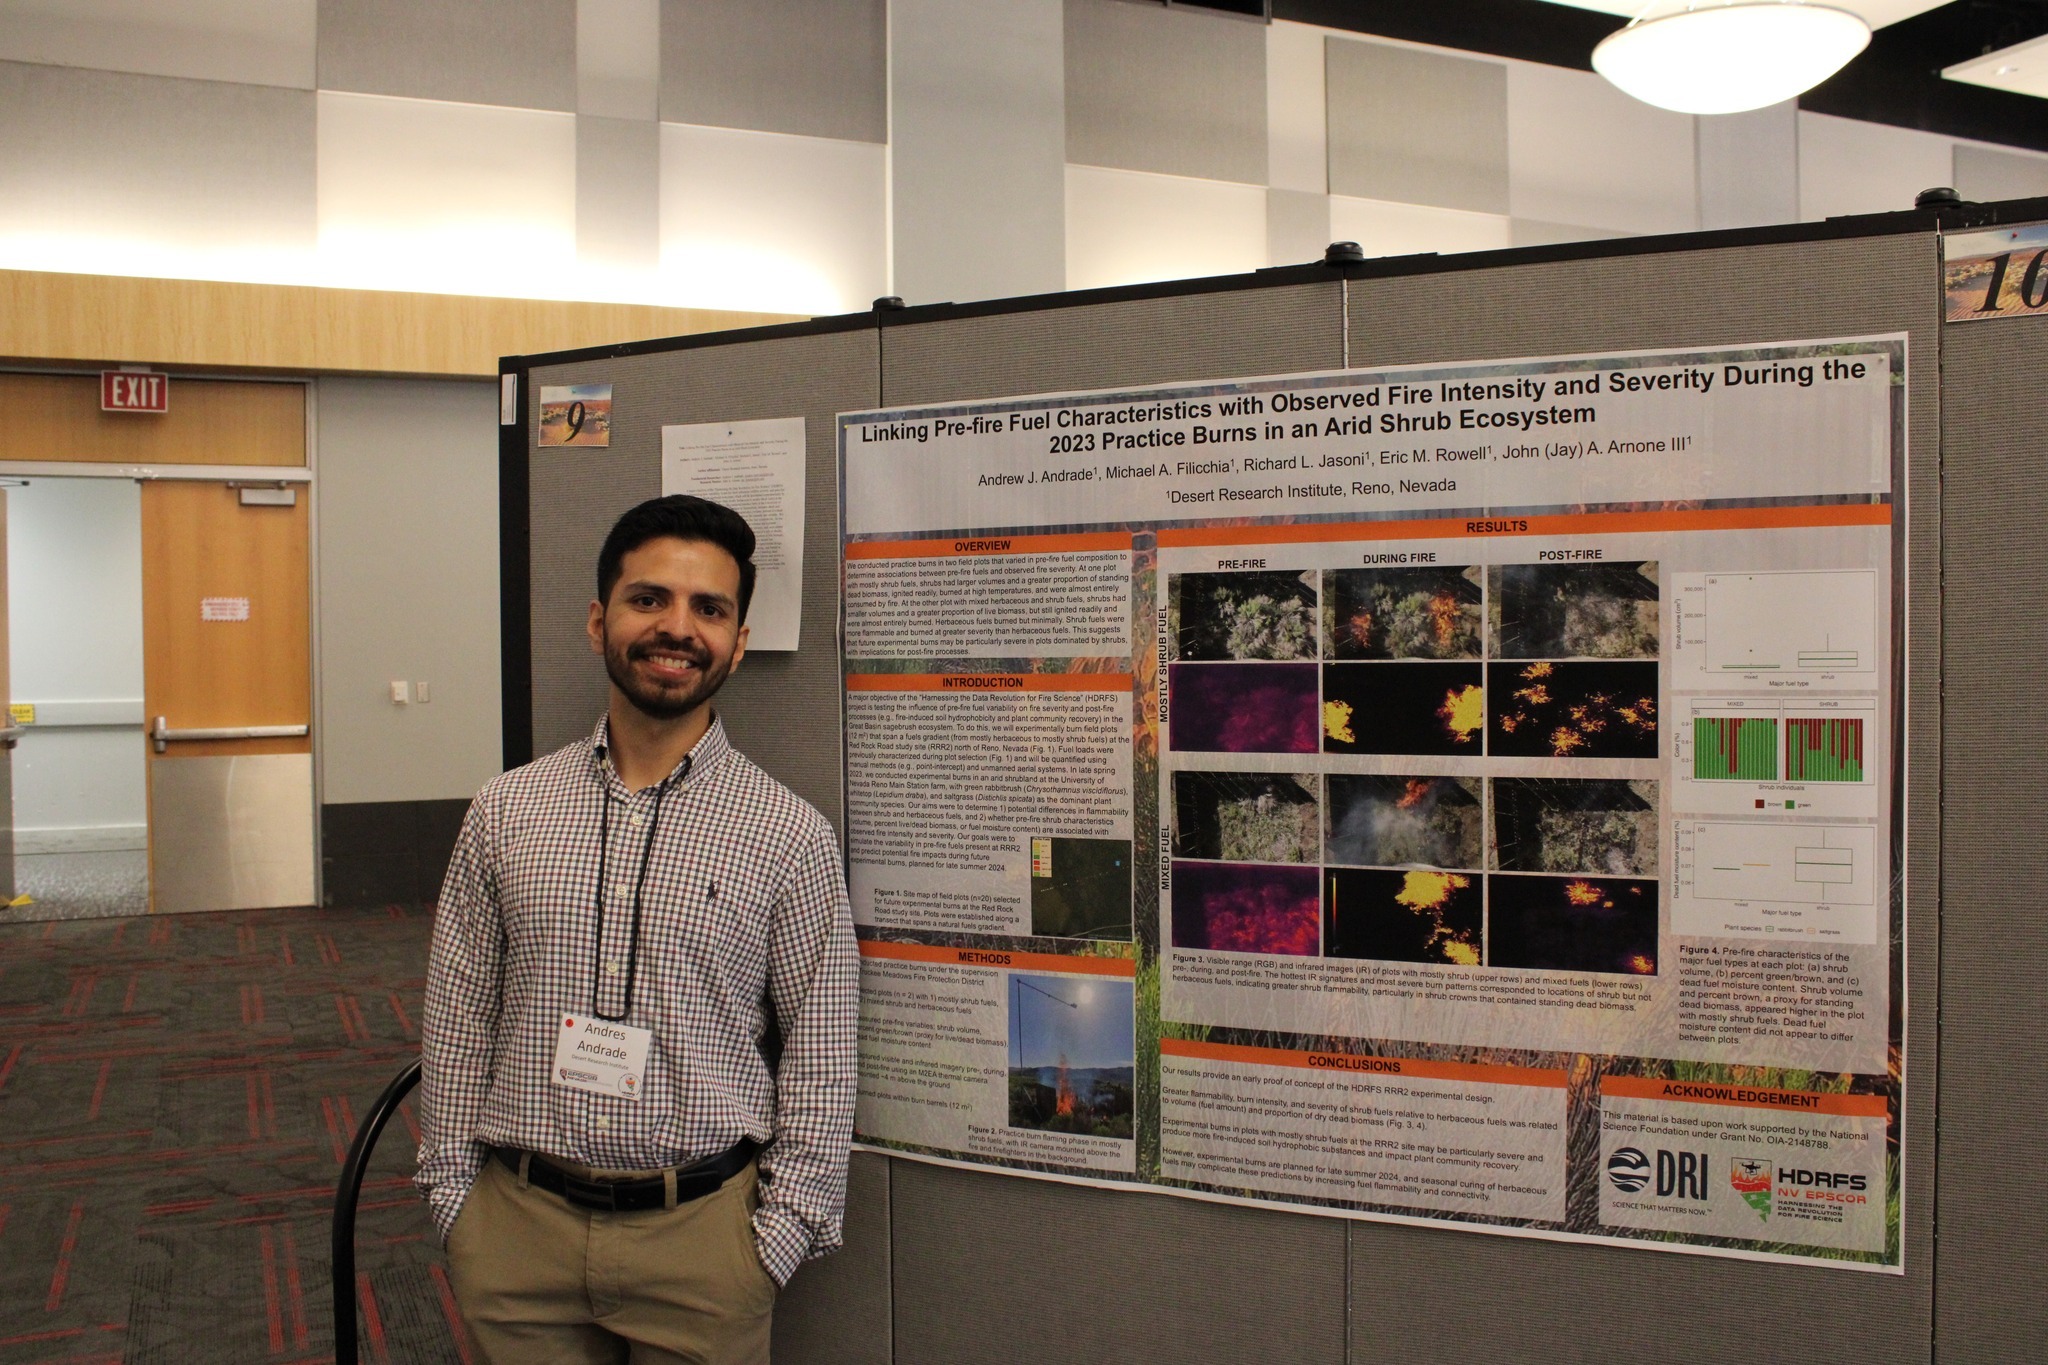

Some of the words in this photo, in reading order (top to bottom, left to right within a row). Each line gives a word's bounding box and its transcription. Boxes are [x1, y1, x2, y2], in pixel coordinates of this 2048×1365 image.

[113, 376, 160, 407] EXIT
[862, 423, 927, 441] Linking
[935, 416, 1002, 436] Pre-fire
[1010, 411, 1049, 431] Fuel
[1057, 401, 1211, 427] Characteristics
[1218, 396, 1262, 416] with
[1271, 387, 1378, 412] Observed
[1388, 385, 1432, 404] Fire
[1441, 378, 1545, 401] Intensity
[1554, 373, 1599, 395] and
[1609, 368, 1714, 392] Severity
[1724, 362, 1812, 385] During
[1822, 360, 1865, 379] the
[564, 401, 586, 442] 9
[1049, 433, 1094, 453] 2023
[1102, 428, 1184, 449] Practice
[1193, 425, 1256, 443] Burns
[1265, 421, 1283, 439] in
[1291, 423, 1317, 438] an
[1324, 414, 1371, 436] Arid
[1380, 411, 1450, 432] Shrub
[1460, 405, 1594, 430] Ecosystem
[978, 473, 1024, 485] Andrew
[1027, 471, 1037, 483] J.
[1106, 464, 1154, 478] Michael
[1158, 463, 1171, 475] A.
[1244, 456, 1296, 471] Richard
[1301, 455, 1313, 468] L.
[1380, 450, 1408, 464] Eric
[1413, 449, 1429, 462] M.
[1502, 444, 1538, 458] John
[1545, 441, 1582, 459] (Jay)
[1586, 441, 1602, 454] A.
[1607, 440, 1665, 453] Arnone
[1219, 485, 1282, 500] Research
[1288, 483, 1346, 497] Institute,
[1352, 481, 1393, 495] Reno,
[1400, 478, 1456, 492] Nevada
[1466, 520, 1527, 532] RESULTS
[954, 540, 1010, 551] OVERVIEW
[1539, 549, 1602, 560] POST-FIRE
[857, 561, 889, 569] conducted
[973, 558, 989, 566] plots
[1035, 555, 1059, 564] pre-fire
[1061, 554, 1074, 562] fuel
[1075, 553, 1118, 562] composition
[1218, 559, 1265, 569] PRE-FIRE
[1363, 553, 1406, 563] DURING
[1410, 552, 1435, 562] FIRE
[942, 677, 1022, 687] INTRODUCTION
[869, 694, 897, 702] objective
[1085, 694, 1117, 702] (HDRFS)
[1159, 678, 1167, 722] MOSTLY
[1161, 824, 1169, 852] FUEL
[1161, 856, 1169, 889] MIXED
[958, 951, 1010, 964] METHODS
[1679, 944, 1708, 955] Figure
[1711, 946, 1719, 954] 4.
[1722, 947, 1754, 956] Pre-fire
[1757, 949, 1821, 959] characteristics
[1823, 952, 1832, 960] of
[1835, 953, 1849, 961] the
[584, 1023, 626, 1041] Andres
[577, 1040, 627, 1060] Andrade
[588, 1058, 608, 1066] Research
[1308, 1055, 1400, 1072] CONCLUSIONS
[1162, 1065, 1175, 1073] Our
[1202, 1071, 1229, 1080] provide
[1242, 1075, 1261, 1084] early
[1294, 1080, 1324, 1089] concept
[1336, 1083, 1348, 1091] the
[1351, 1084, 1381, 1093] HDRFS
[1384, 1086, 1408, 1095] RRR2
[1410, 1090, 1462, 1100] experimental
[1464, 1093, 1494, 1104] design.
[1662, 1084, 1819, 1107] ACKNOWLEDGEMENT
[1602, 1121, 1637, 1132] Science
[1639, 1124, 1689, 1135] Foundation
[1691, 1130, 1717, 1138] under
[1720, 1131, 1745, 1141] Grant
[1748, 1134, 1763, 1142] No.
[1766, 1135, 1830, 1149] OIA-2148788.
[1603, 1110, 1621, 1119] This
[1623, 1113, 1658, 1122] material
[1661, 1114, 1668, 1123] is
[1671, 1116, 1697, 1125] based
[1700, 1120, 1722, 1128] upon
[1725, 1122, 1747, 1130] work
[1749, 1124, 1795, 1134] supported
[1798, 1127, 1809, 1137] by
[1812, 1129, 1826, 1137] the
[1829, 1130, 1868, 1140] National
[1656, 1149, 1707, 1200] DRI
[1778, 1167, 1866, 1190] HDRFS
[1778, 1188, 1798, 1197] NV
[1806, 1190, 1866, 1203] EPSCOR
[1612, 1201, 1638, 1209] SCIENCE
[1657, 1205, 1686, 1213] MATTERS
